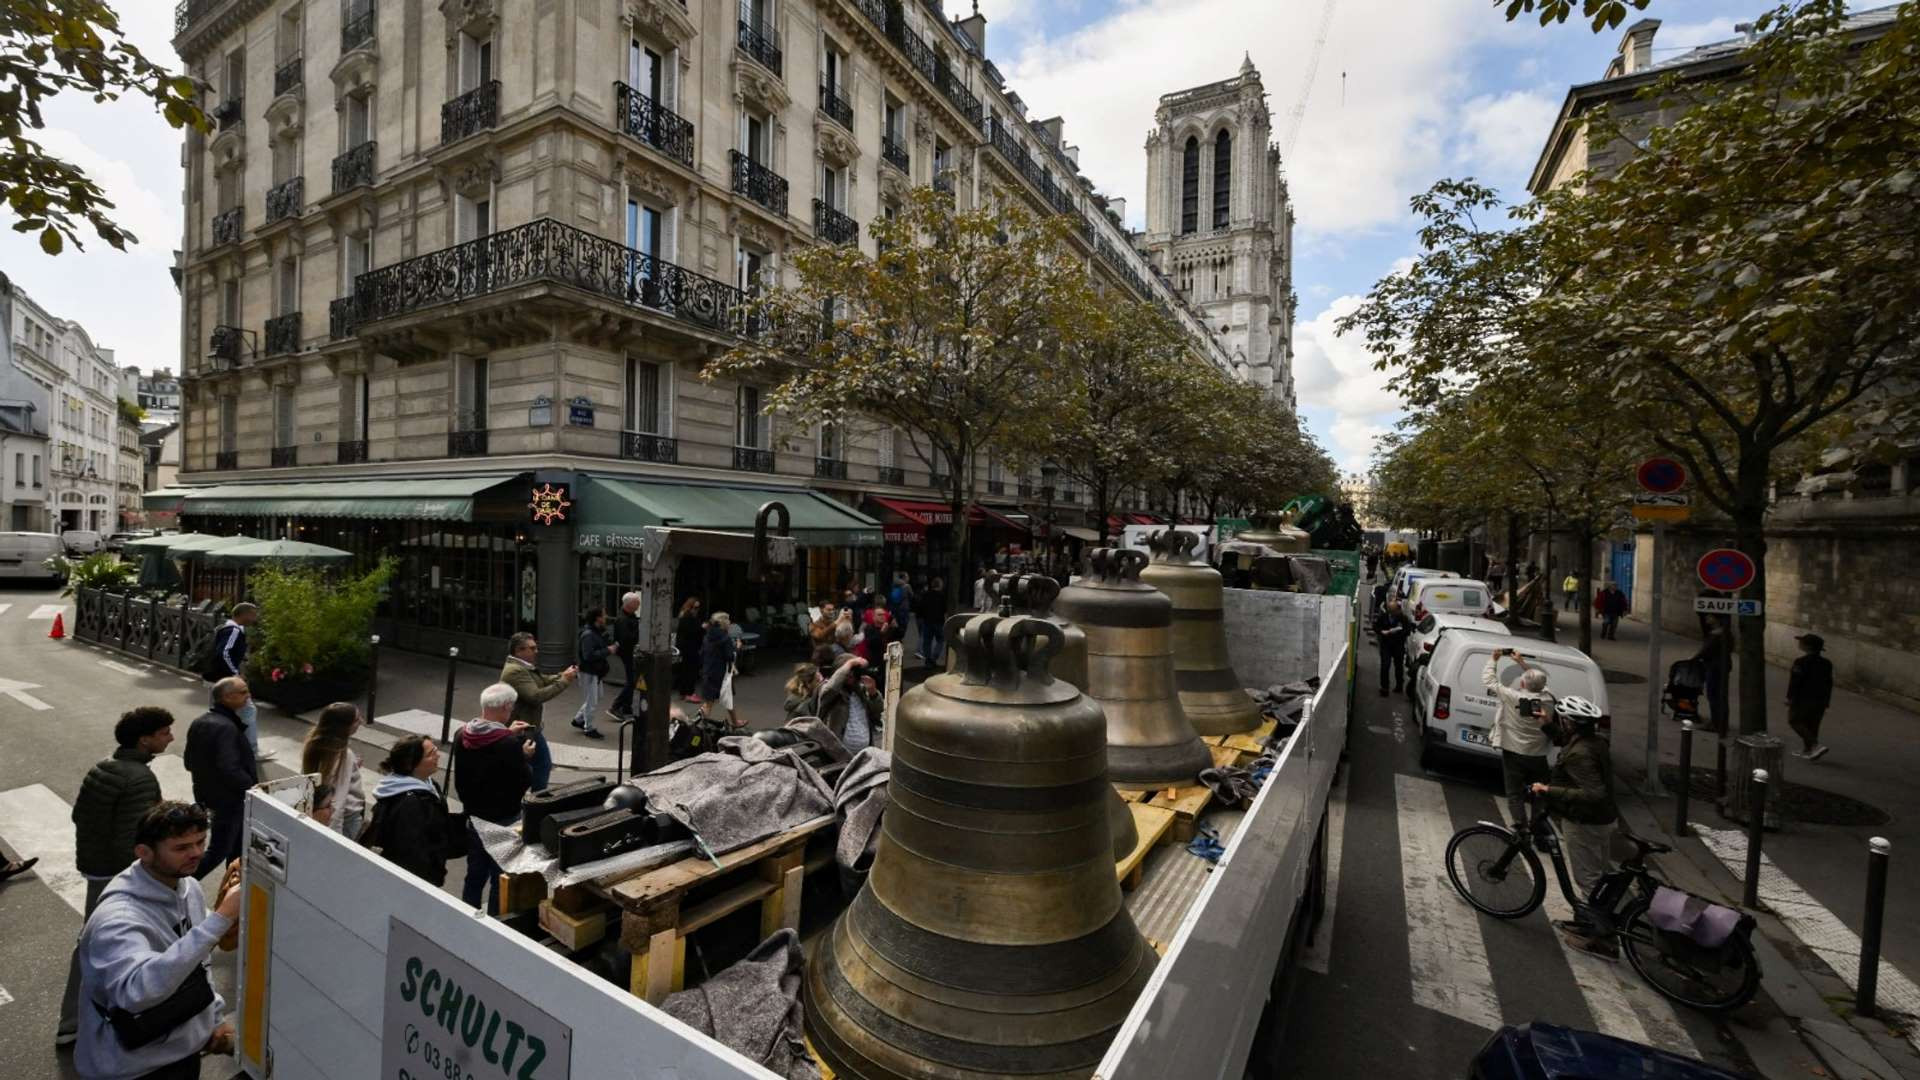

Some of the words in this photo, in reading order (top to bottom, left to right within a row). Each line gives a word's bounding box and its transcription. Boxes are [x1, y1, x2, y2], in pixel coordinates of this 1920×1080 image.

[1698, 601, 1735, 611] SAUF
[400, 956, 546, 1080] SCHULTZ
[424, 1041, 440, 1071] 03
